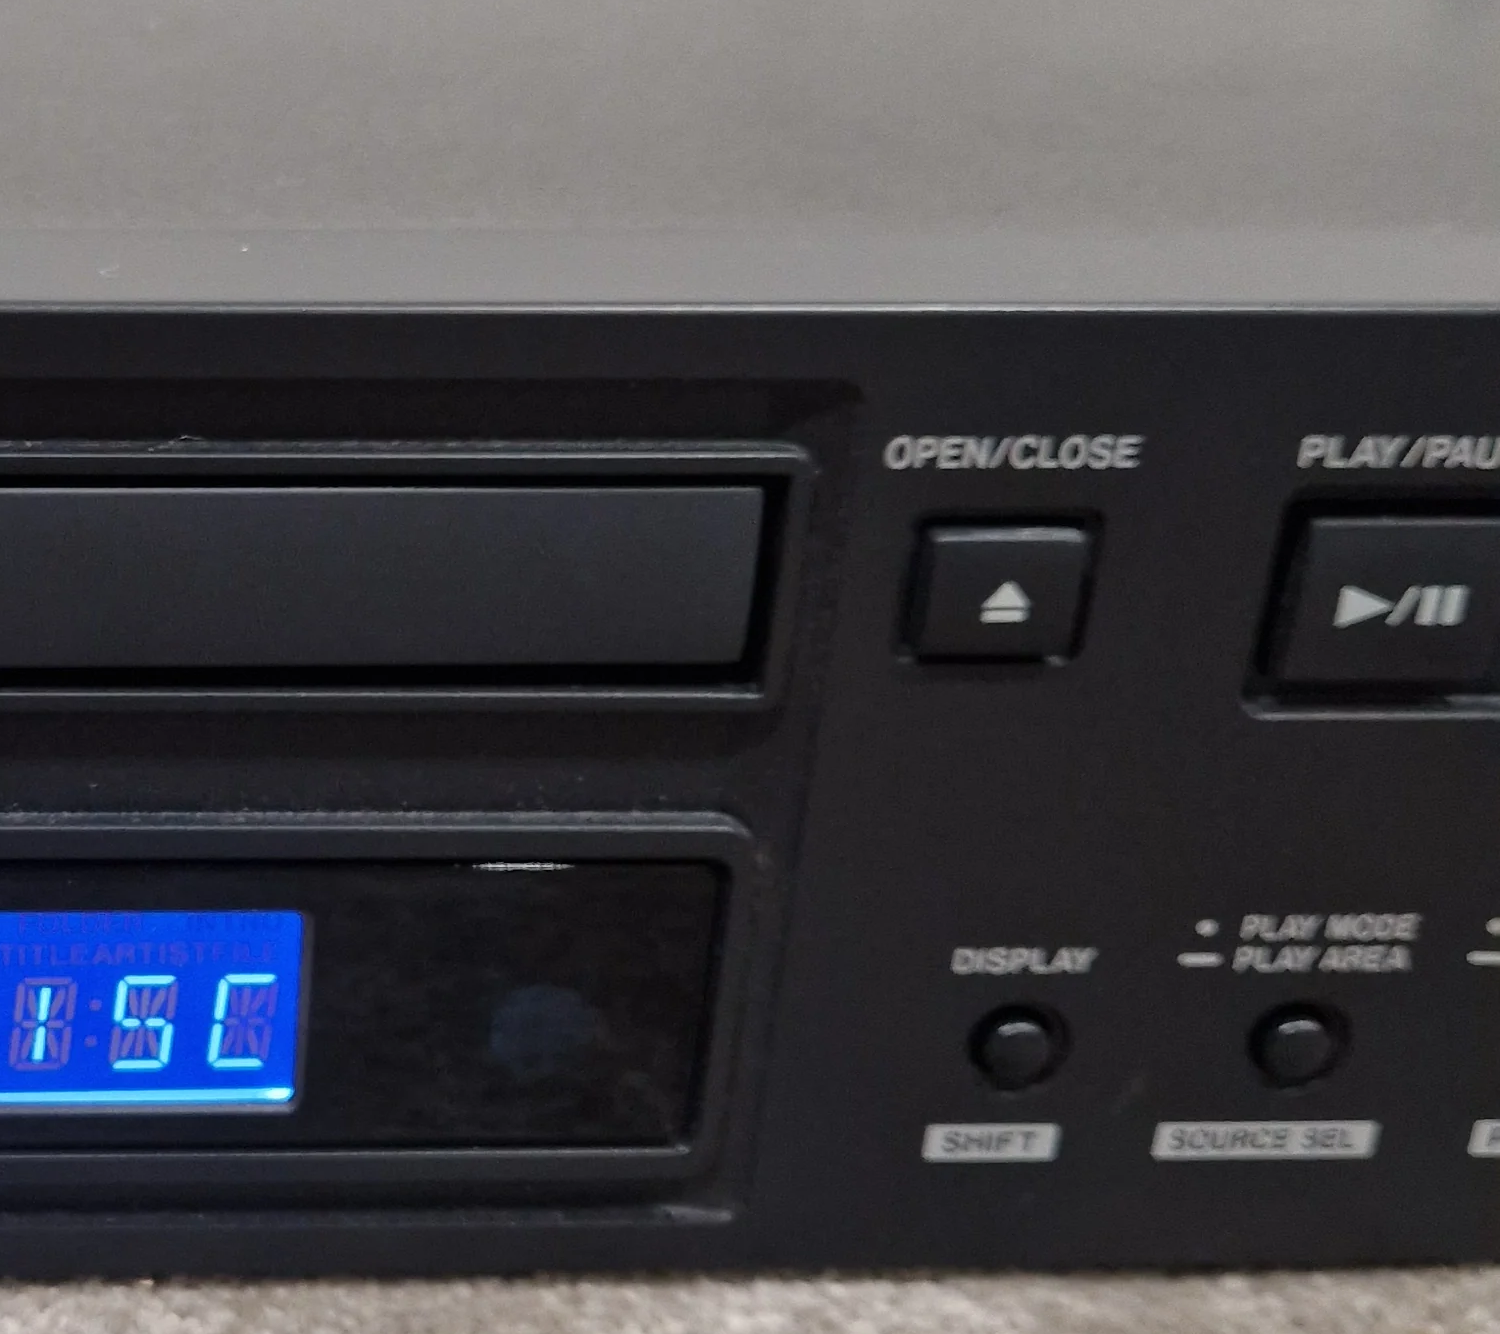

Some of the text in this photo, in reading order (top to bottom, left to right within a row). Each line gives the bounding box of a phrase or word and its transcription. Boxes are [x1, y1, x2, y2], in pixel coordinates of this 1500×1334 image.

[884, 434, 1146, 469] OPEN/CLOSE
[1240, 912, 1421, 942] PLAY MODE
[950, 946, 1099, 975] DISPLAY
[1232, 944, 1412, 973] PLAY AREA
[941, 1129, 1040, 1154] SHIFT
[1167, 1127, 1356, 1152] SOURCE SEL
